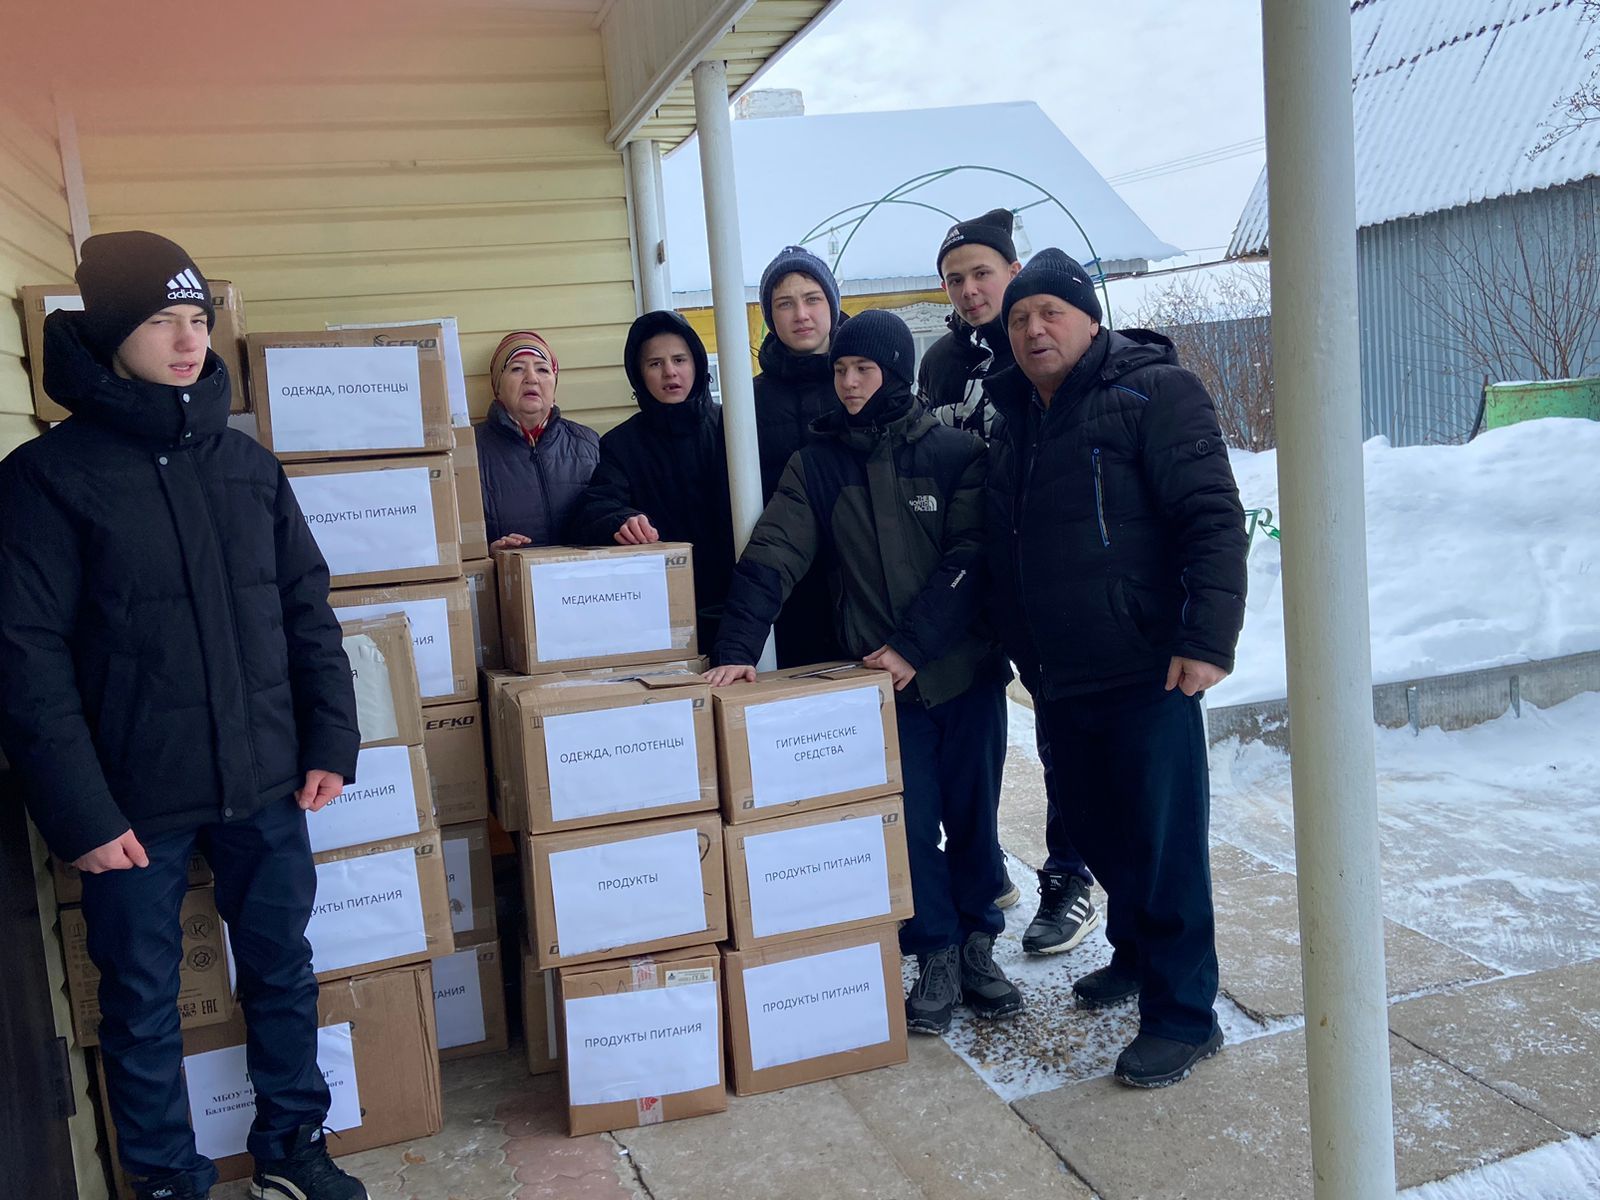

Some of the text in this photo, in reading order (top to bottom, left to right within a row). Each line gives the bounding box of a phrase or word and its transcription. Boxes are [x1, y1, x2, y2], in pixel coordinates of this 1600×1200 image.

[167, 289, 204, 300] adidas
[281, 382, 409, 397] ОДЕЖДА, ПОЛОТЕНЦЫ
[365, 505, 417, 519] ПИТАНИЯ
[561, 591, 642, 606] МЕДИКАМЕНТЫ
[426, 716, 475, 731] EFKO
[775, 725, 858, 749] ГИГИЕНИЧЕСКИЕ
[560, 737, 684, 764] ОДЕЖДА, ПОЛОТЕНЦЫ
[794, 744, 844, 762] СРЕДСТВА
[339, 784, 396, 803] ПИТАНИЯ
[765, 853, 872, 882] ПРОДУКТЫ ПИТАНИЯ
[598, 873, 659, 891] ПРОДУКТЫ
[311, 889, 403, 916] УКТЫ ПИТАНИЯ
[432, 985, 465, 999] ТАНИЯ
[762, 981, 870, 1013] ПРОДУКТЫ ПИТАНИЯ
[584, 1022, 702, 1048] ПРОДУКТЫ ПИТАНИЯ
